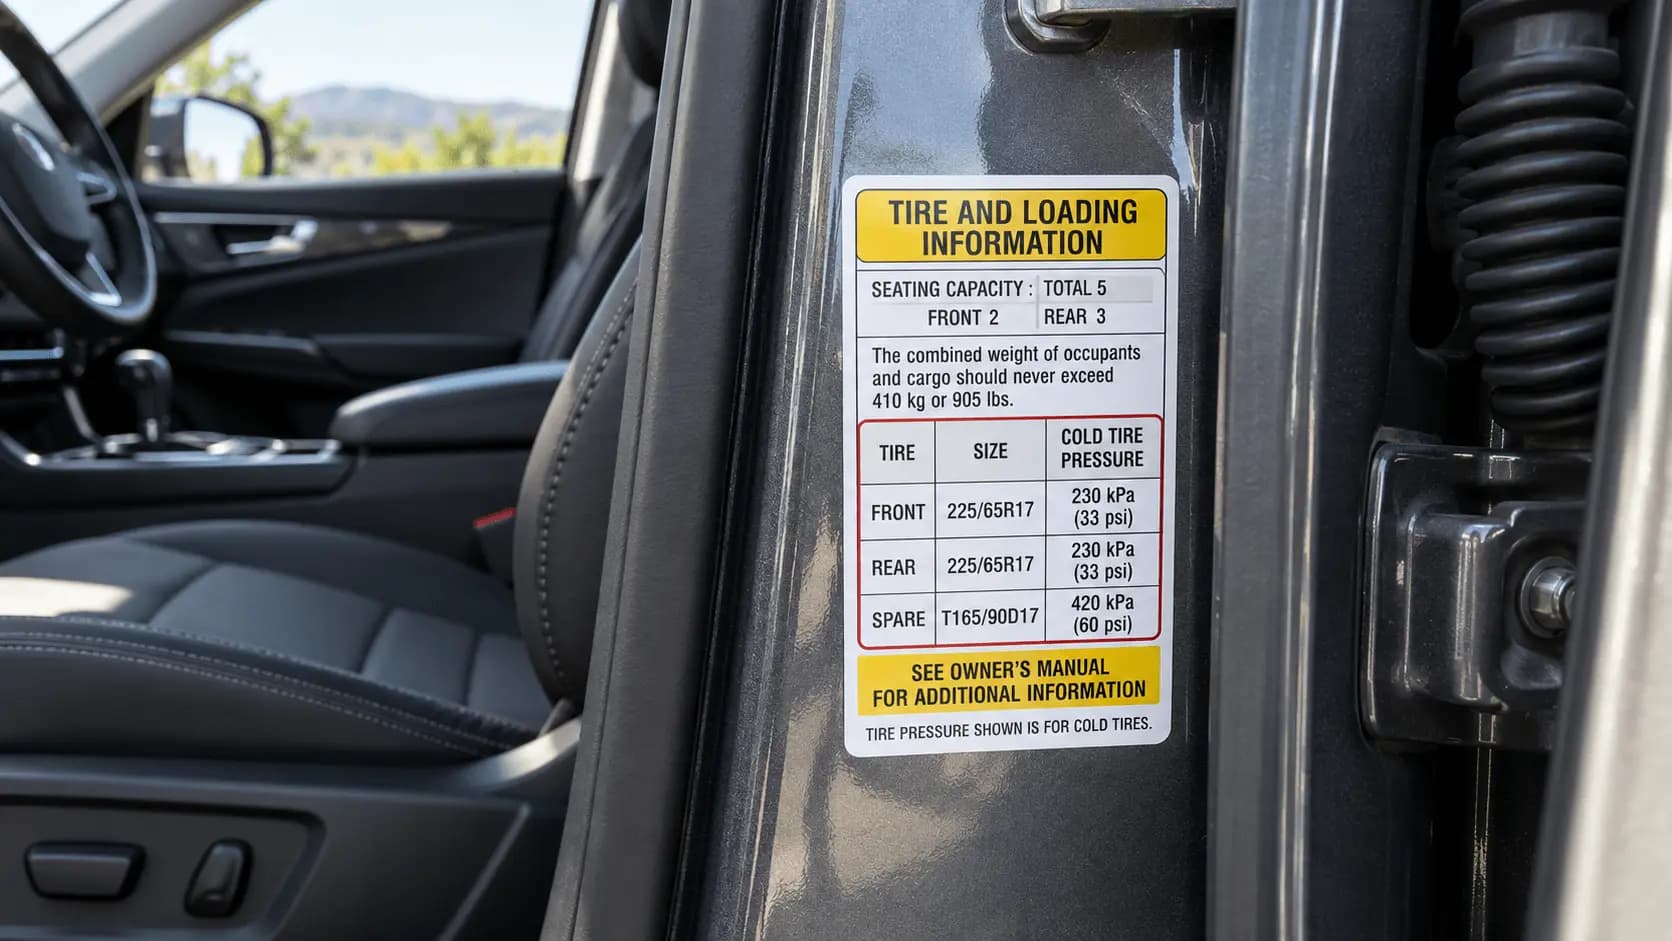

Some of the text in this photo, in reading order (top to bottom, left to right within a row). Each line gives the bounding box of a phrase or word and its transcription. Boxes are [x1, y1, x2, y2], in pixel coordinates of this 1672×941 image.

[889, 199, 1137, 224] TIRE AND LOADING
[923, 230, 1102, 255] INFORMATION
[872, 281, 939, 297] SEATING
[947, 280, 1023, 297] CAPACITY
[1044, 280, 1106, 296] TOTAL 5
[929, 309, 998, 326] FRONT 2
[1045, 308, 1105, 324] REAR 3
[872, 345, 1140, 365] The combined weight of occupants
[873, 367, 1113, 389] and cargo should never exceed
[873, 391, 1013, 411] 410 kg or 905 lbs.
[1062, 427, 1143, 445] COLD TIRE
[880, 444, 915, 461] TIRE
[974, 443, 1008, 459] SIZE
[1062, 451, 1143, 468] PRESSURE
[1072, 487, 1135, 503] 230 kPa
[872, 504, 925, 520] FRONT
[948, 501, 1034, 519] 225/65R17
[1075, 508, 1132, 530] (33 psi)
[1072, 541, 1134, 558] 230 kPa
[873, 559, 915, 576] REAR
[948, 556, 1033, 574] 225/65R17
[1075, 562, 1132, 583] (33 psi)
[1072, 594, 1134, 611] 420 kPa
[873, 611, 925, 628] SPARE
[942, 608, 1038, 625] T165/90D17
[1074, 615, 1132, 636] (60 psi)
[912, 664, 944, 681] SEE
[1038, 658, 1109, 677] MANUAL
[874, 680, 1145, 707] FOR ADDITIONAL INFORMATION
[866, 717, 1152, 741] TIRE PRESSURE SHOWN IS FOR COLD TIRES.
